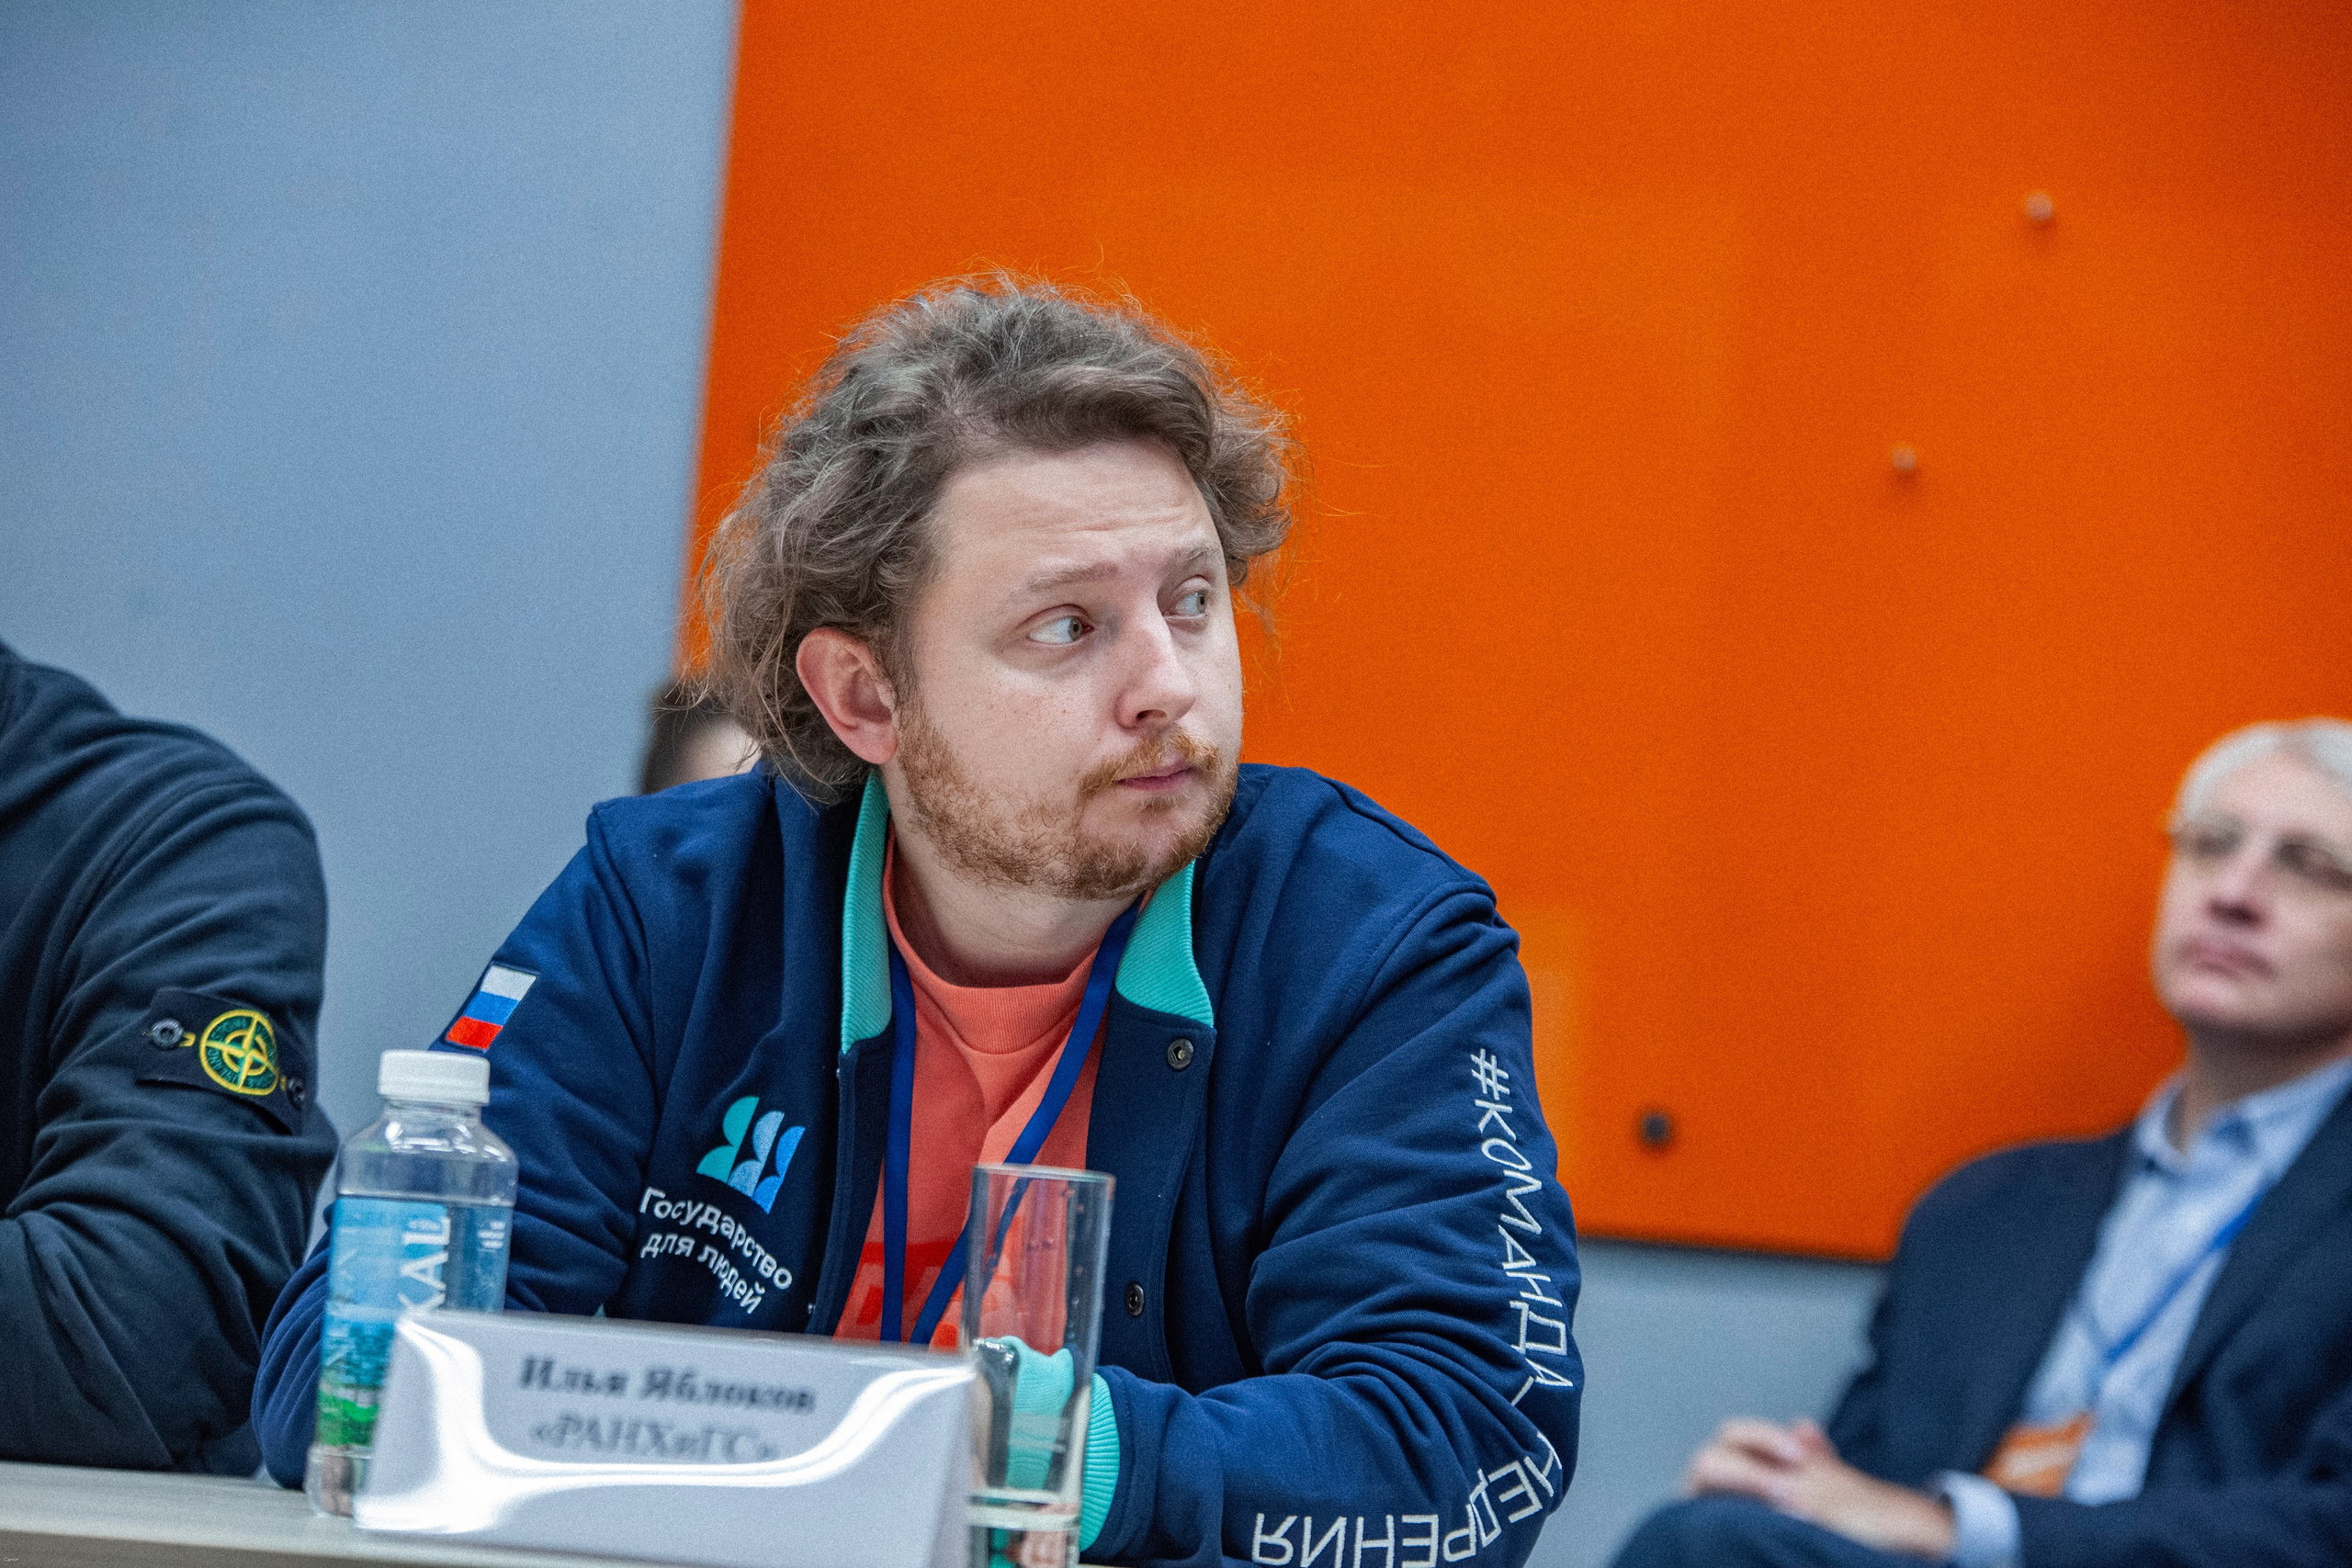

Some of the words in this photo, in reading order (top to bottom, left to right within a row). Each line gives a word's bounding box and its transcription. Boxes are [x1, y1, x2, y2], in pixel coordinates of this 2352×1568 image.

[398, 1214, 451, 1314] KAL
[639, 1186, 792, 1290] Государство
[640, 1233, 695, 1258] для
[696, 1244, 765, 1314] людей
[520, 1355, 628, 1399] Илья
[640, 1366, 816, 1416] Яблоков
